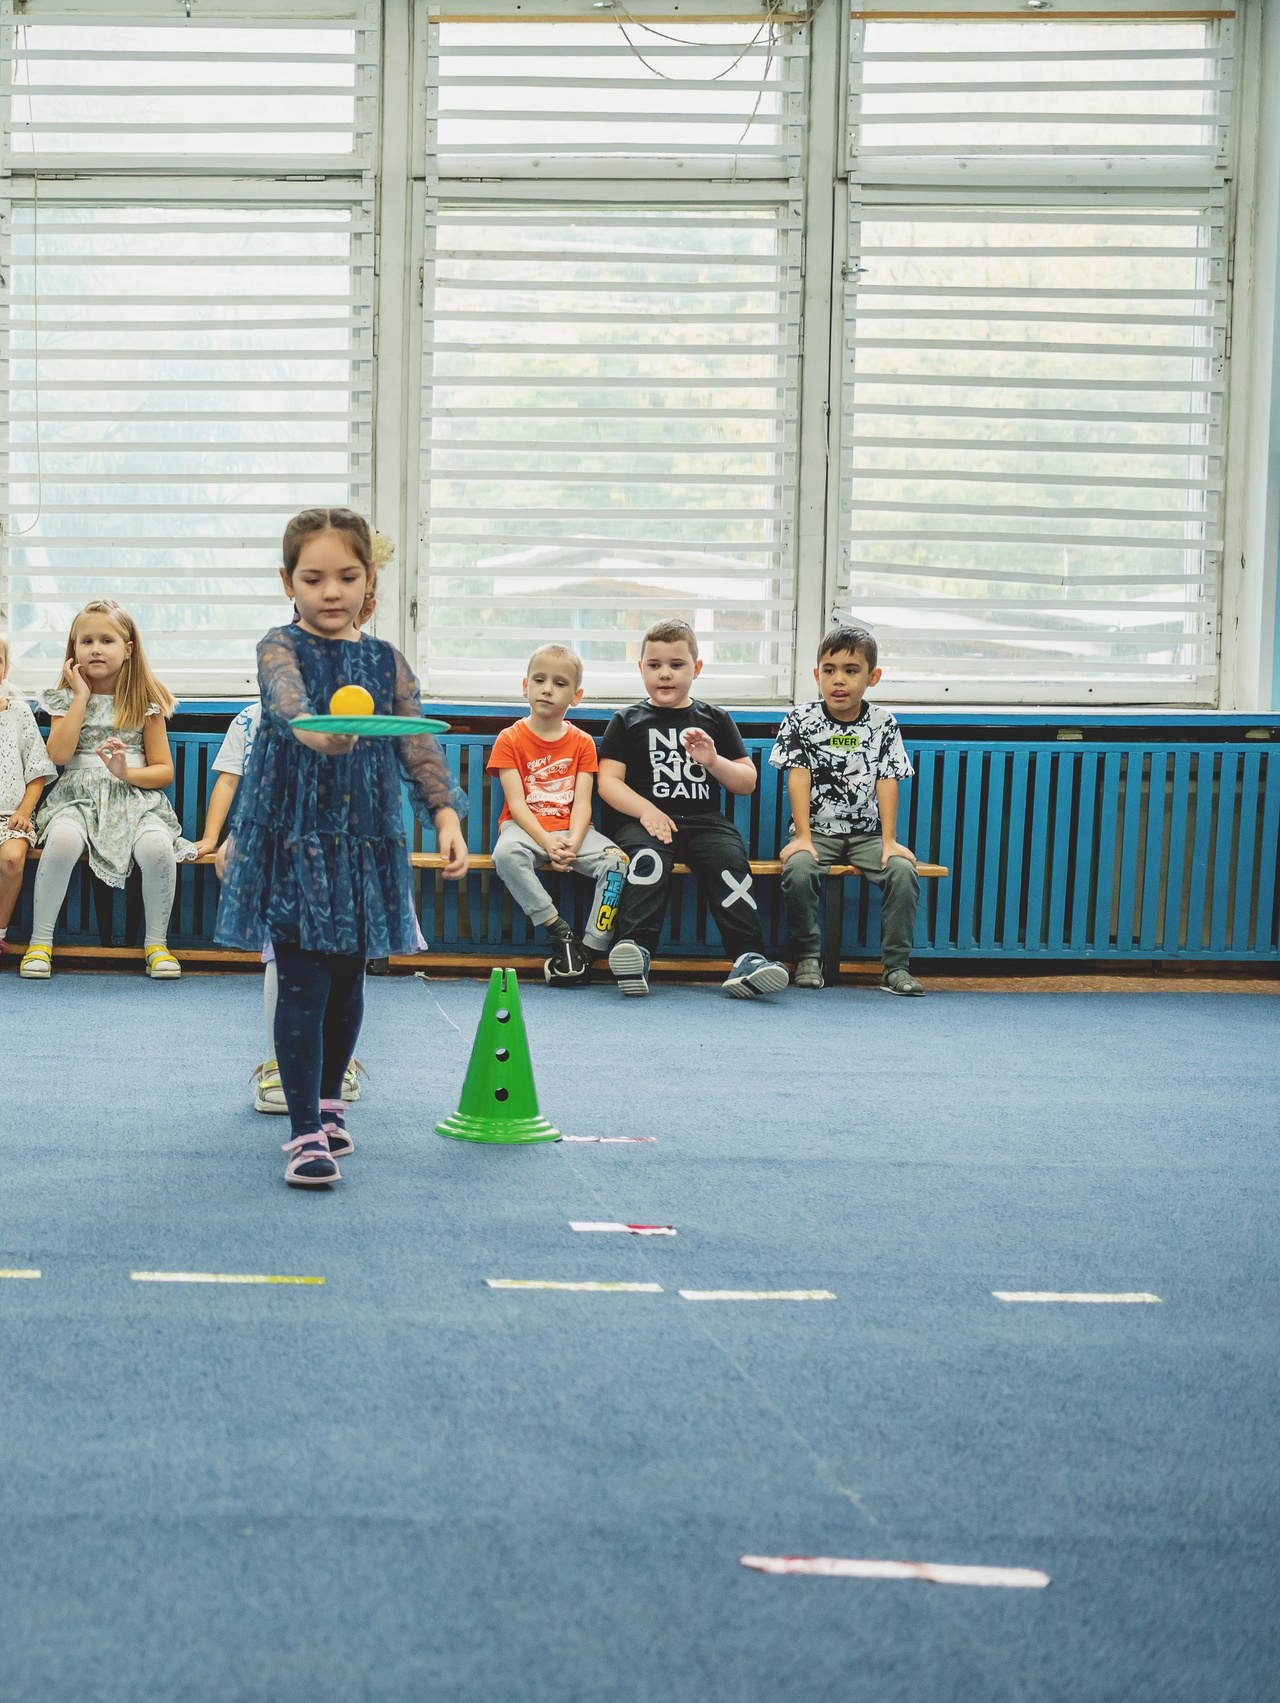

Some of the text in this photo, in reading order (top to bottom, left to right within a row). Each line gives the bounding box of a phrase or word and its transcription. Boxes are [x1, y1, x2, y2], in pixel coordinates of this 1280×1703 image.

[832, 737, 857, 746] EVER
[652, 762, 707, 783] NO
[652, 782, 710, 800] GAIN
